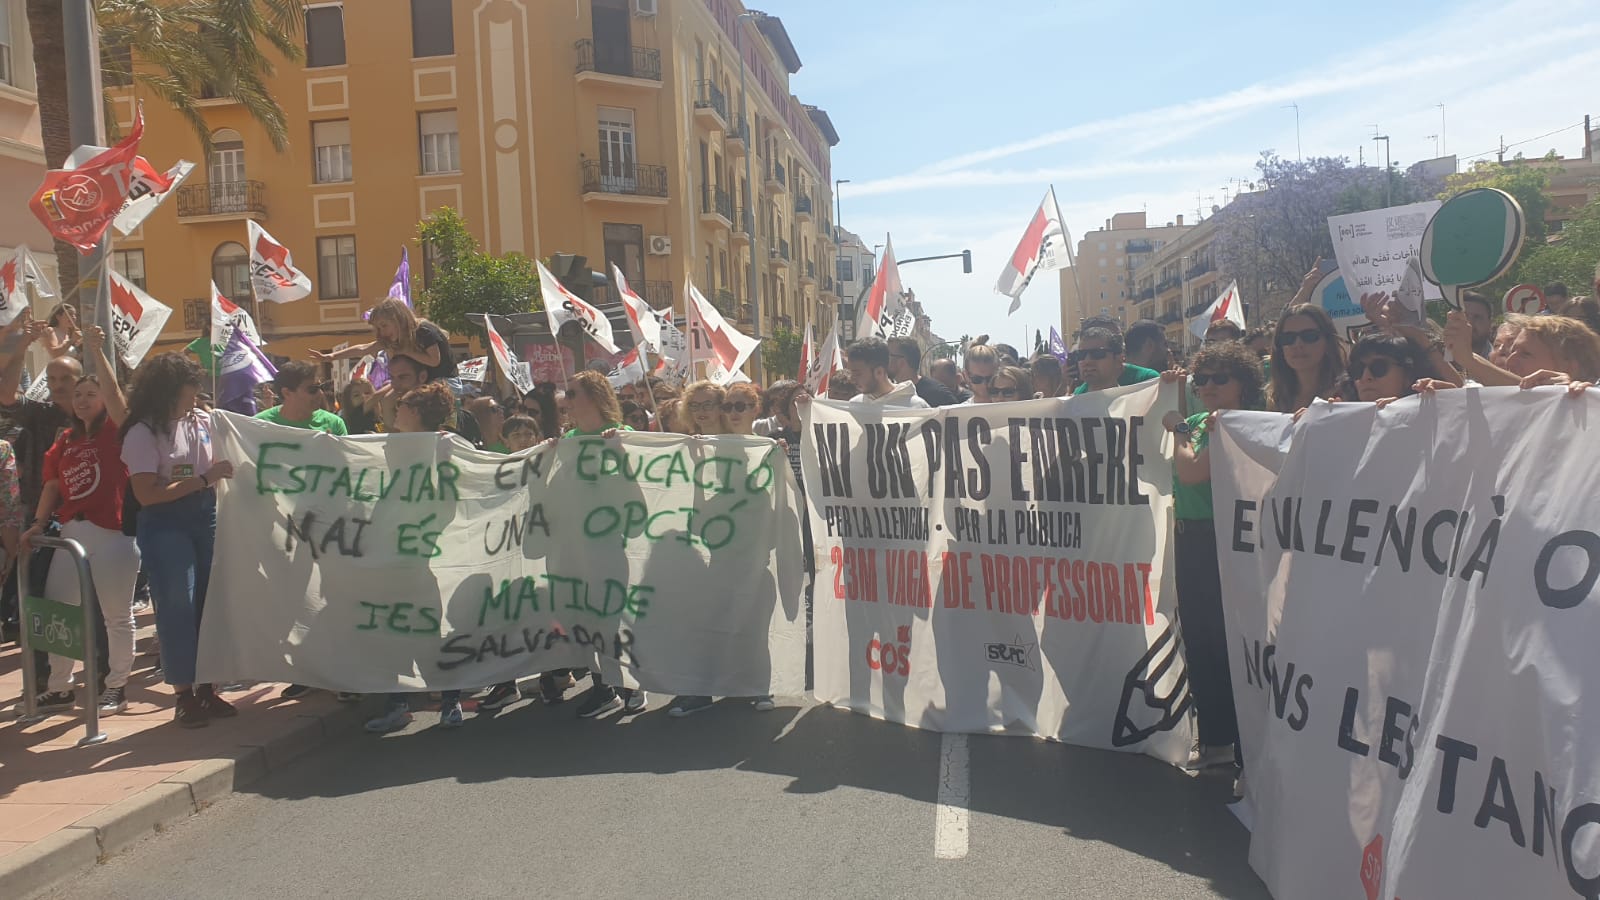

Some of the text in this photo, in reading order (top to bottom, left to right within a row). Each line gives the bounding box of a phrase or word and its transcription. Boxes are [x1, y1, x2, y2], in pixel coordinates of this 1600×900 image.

[256, 441, 461, 502] ESTALVIAR
[494, 452, 543, 490] EN
[576, 440, 777, 495] EDUCACIÓ
[814, 423, 853, 498] NI
[865, 423, 916, 499] UN
[921, 416, 991, 501] PAS
[1008, 416, 1150, 505] ENRERE
[285, 499, 748, 560] MAI ÉS UNA OPCIÓ
[825, 504, 1082, 549] PER LA LLENGUA PER LA PÚBLICA
[356, 574, 655, 633] IES MATILDE
[830, 545, 1155, 625] 23M VAGA DE PROFESSORAT
[437, 624, 640, 670] SALVADOR
